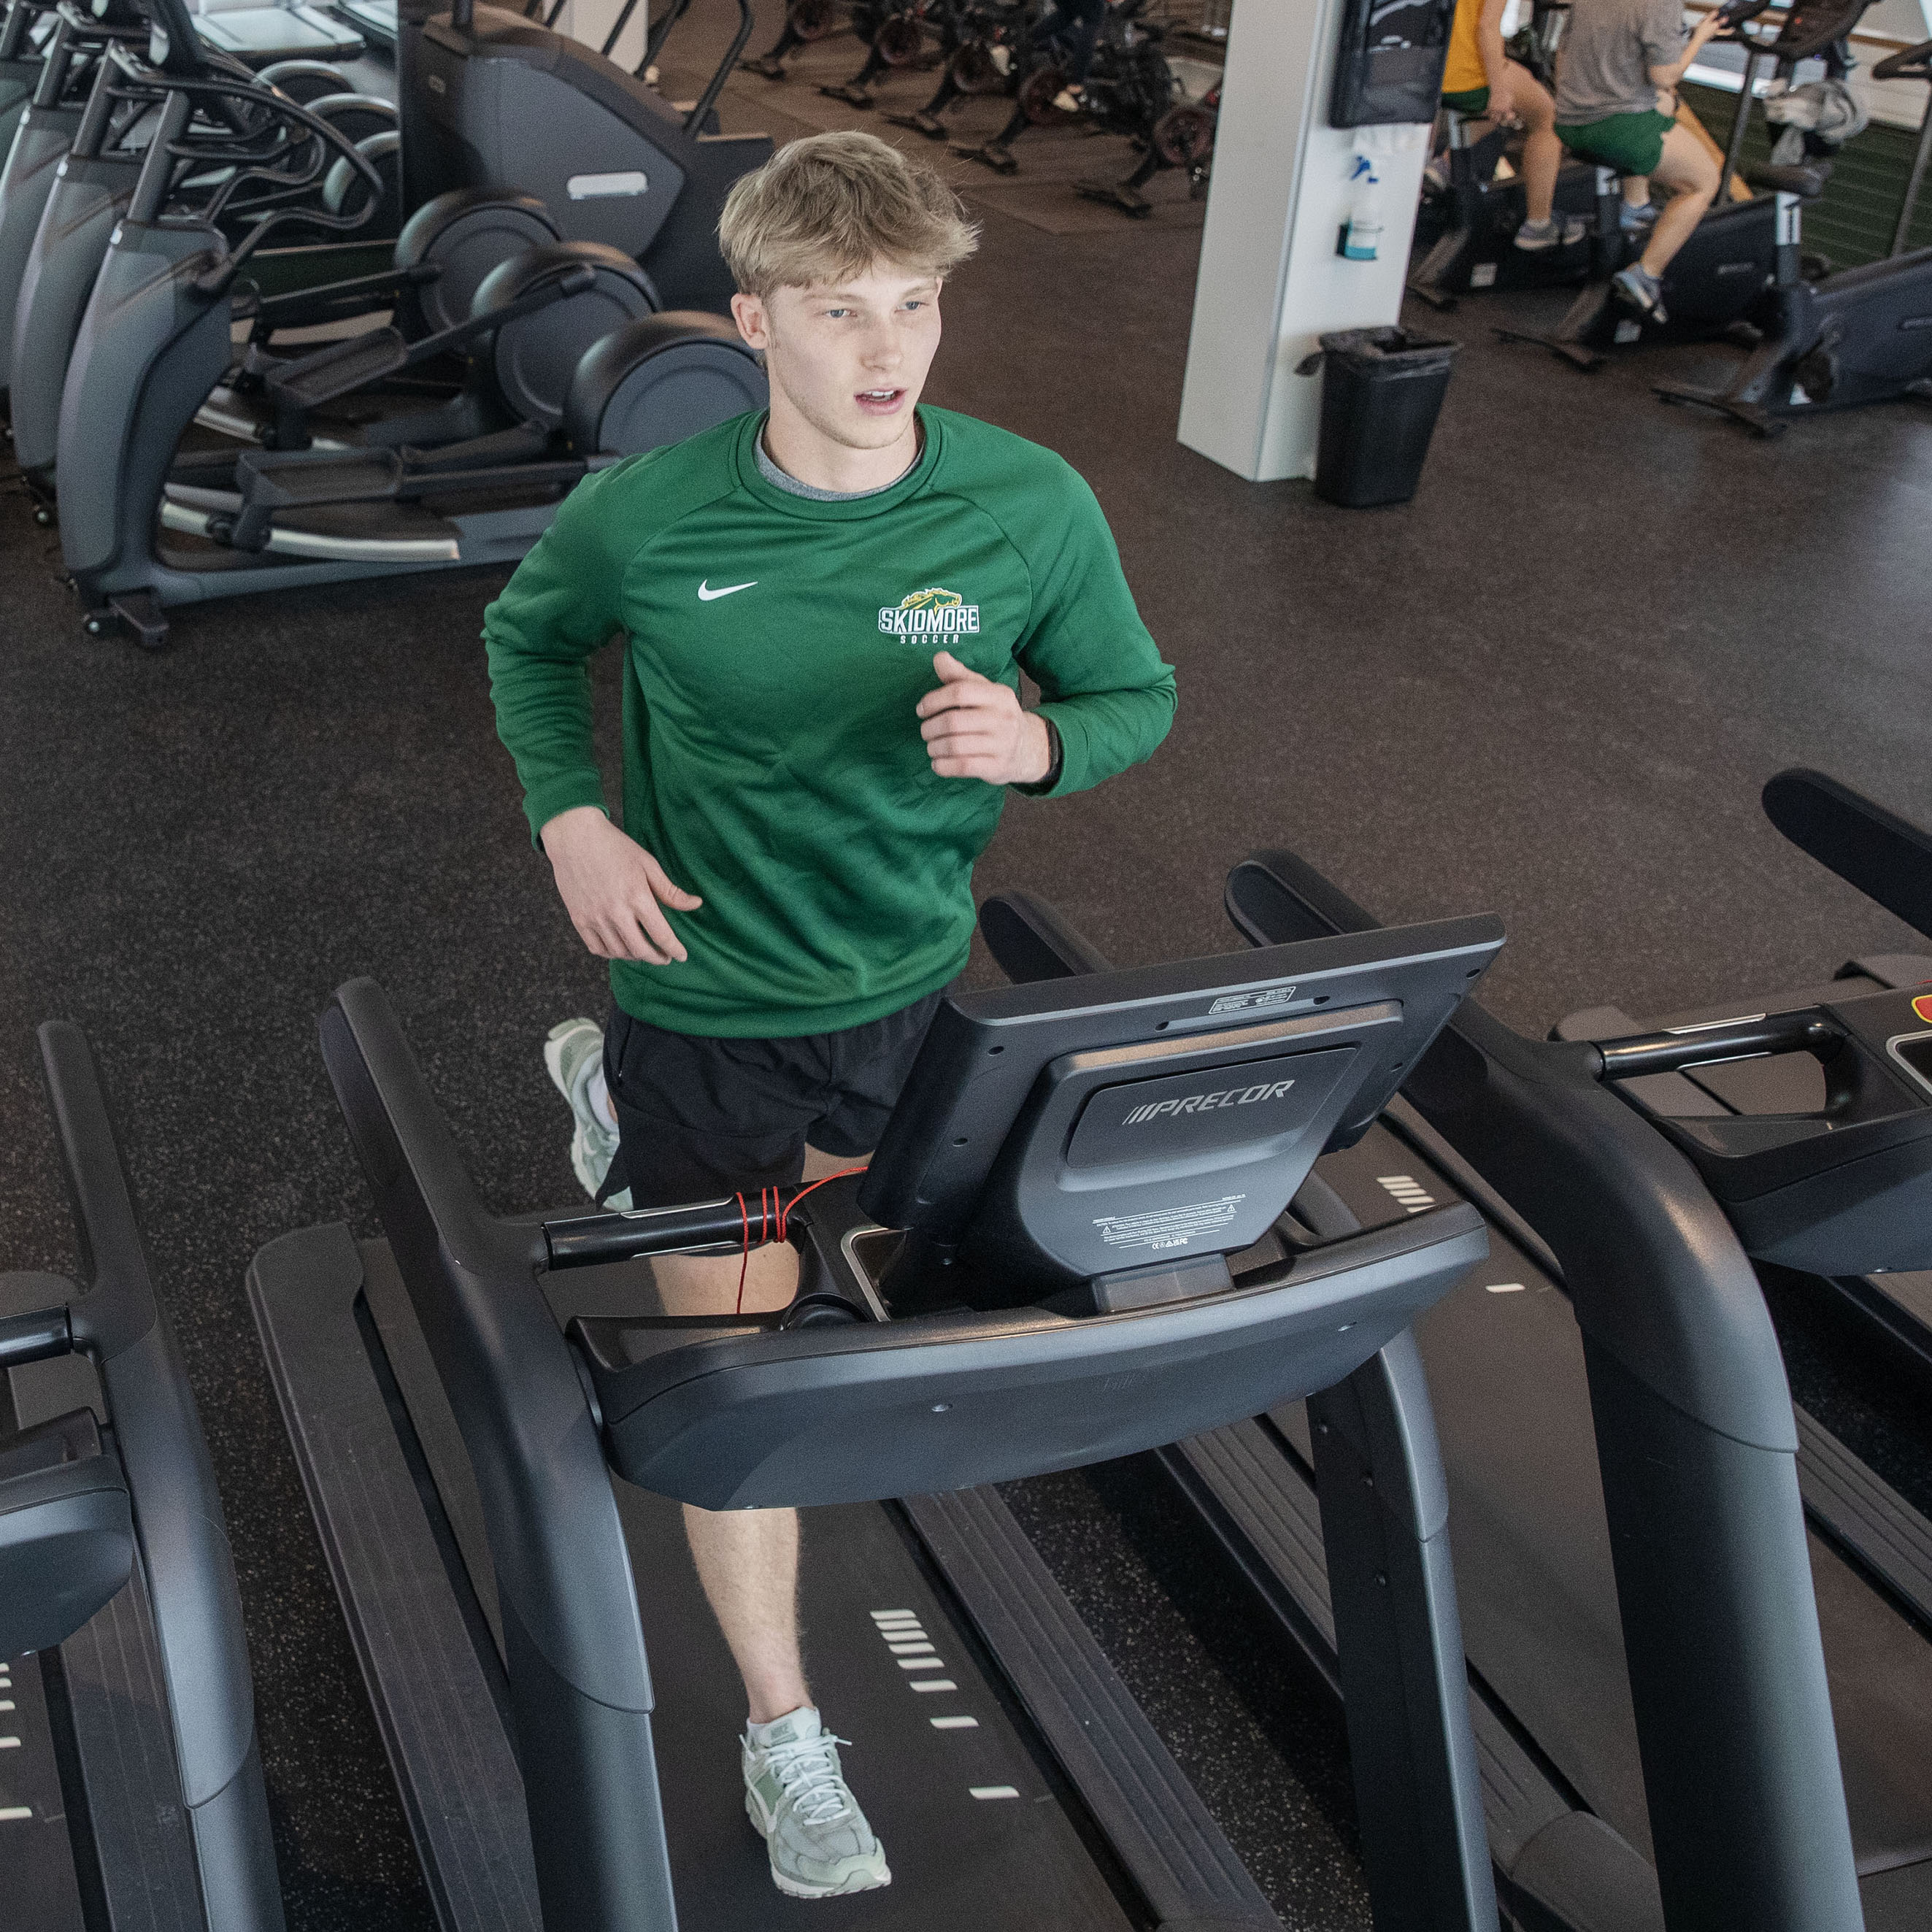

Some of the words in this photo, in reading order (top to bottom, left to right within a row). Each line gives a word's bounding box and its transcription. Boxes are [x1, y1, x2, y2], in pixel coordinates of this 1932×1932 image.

[881, 609, 977, 632] SKIDMORE
[900, 634, 959, 644] SOCCER
[1144, 1079, 1296, 1122] PRECOR
